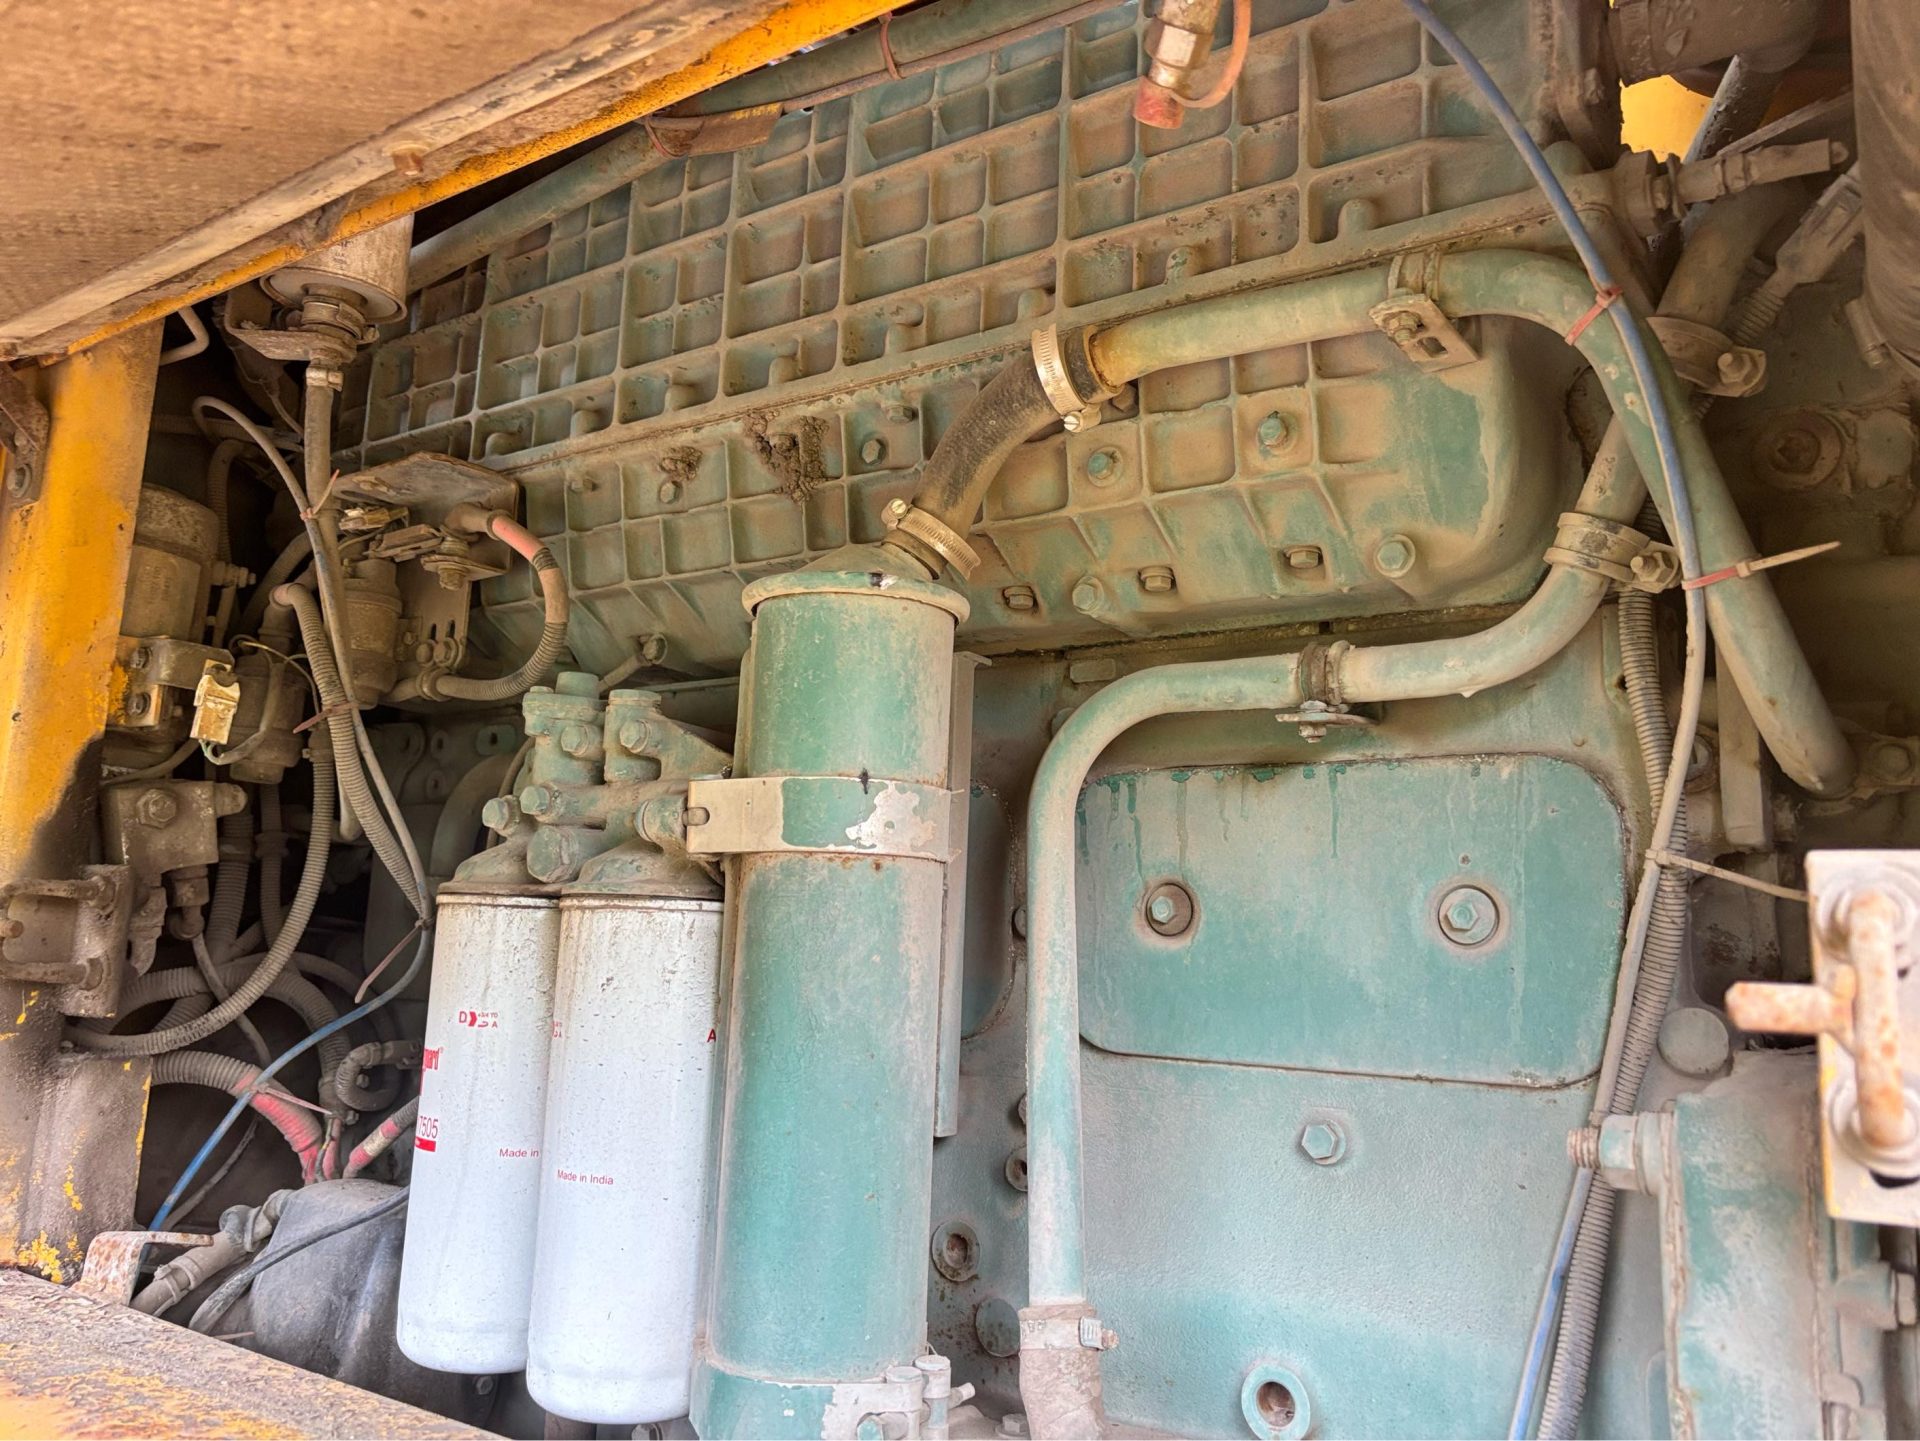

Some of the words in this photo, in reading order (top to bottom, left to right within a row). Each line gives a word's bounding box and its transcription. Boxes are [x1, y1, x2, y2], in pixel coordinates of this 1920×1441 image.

[499, 1148, 527, 1158] Made
[530, 1148, 539, 1158] in
[557, 1169, 577, 1182] Made
[579, 1174, 587, 1183] in
[590, 1174, 614, 1185] India
